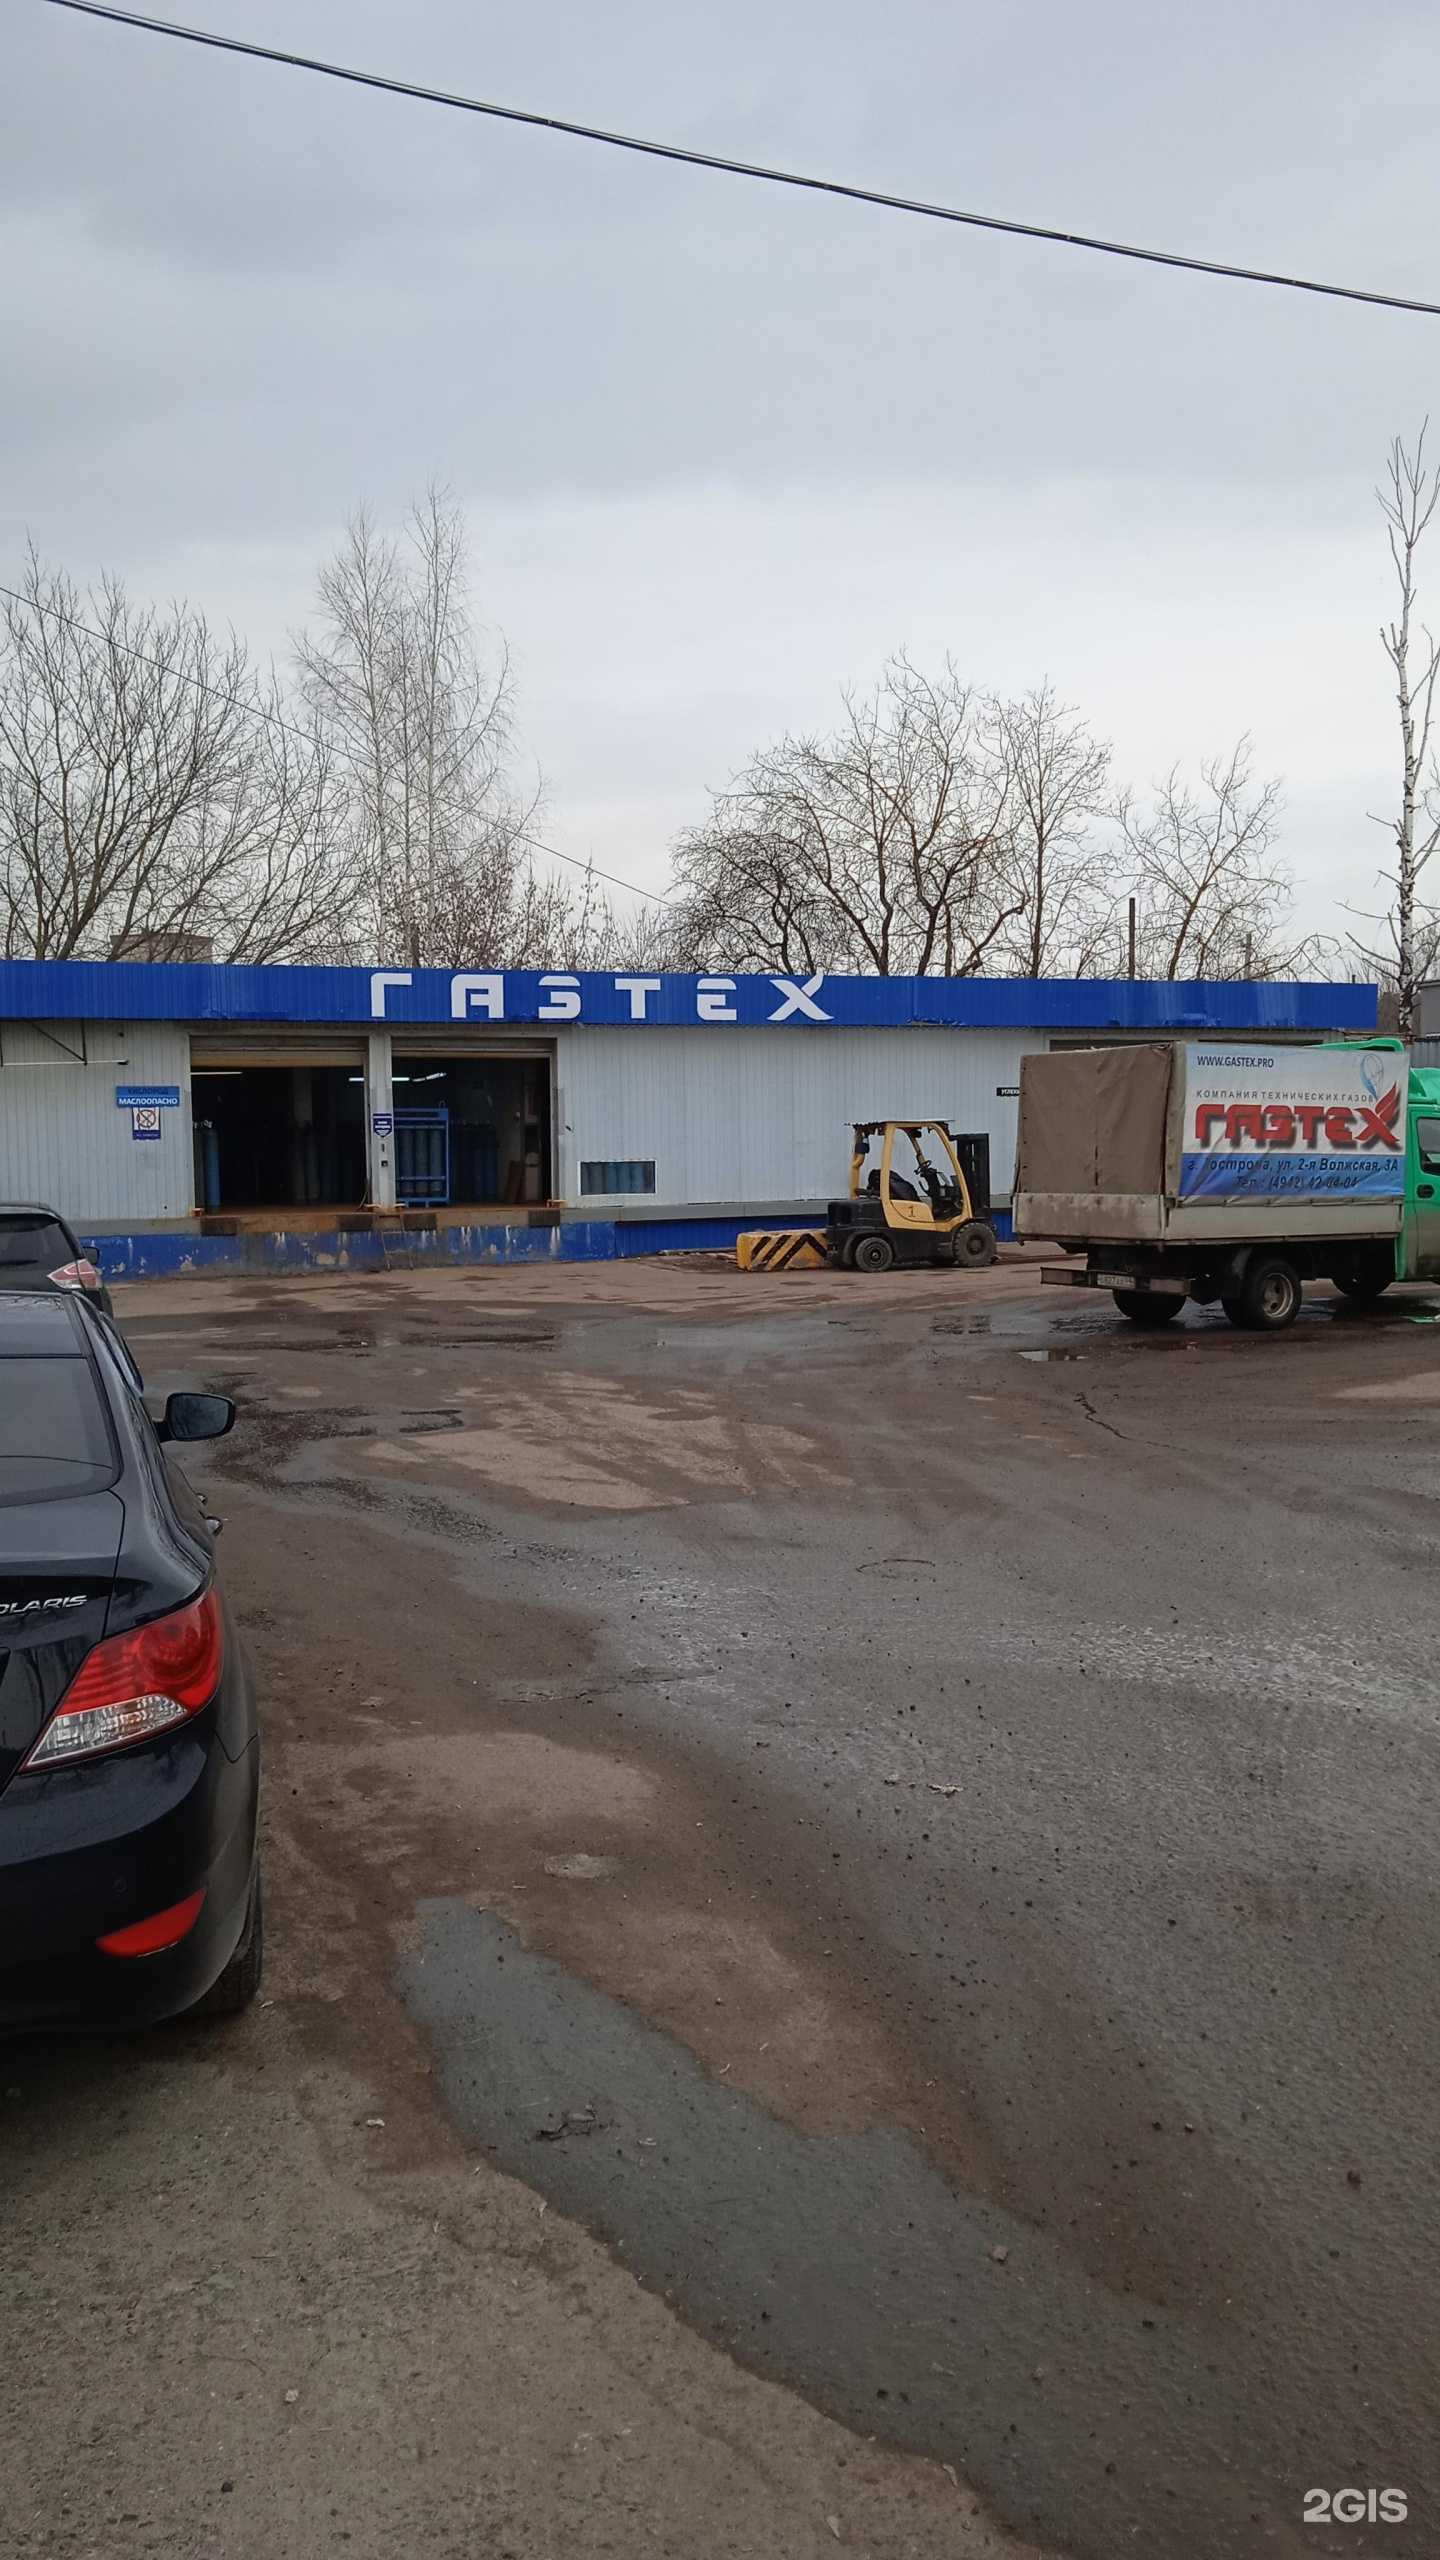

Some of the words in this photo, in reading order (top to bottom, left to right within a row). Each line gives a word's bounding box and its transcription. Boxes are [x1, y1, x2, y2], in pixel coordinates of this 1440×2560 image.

[1197, 1056, 1275, 1068] WWW.GASTEX.PRO
[119, 1097, 178, 1105] МАСЛООПАСНО
[1196, 1090, 1258, 1099] КОМПАНИЯ
[1261, 1091, 1338, 1102] ТЕХНИЧЕСКИХ
